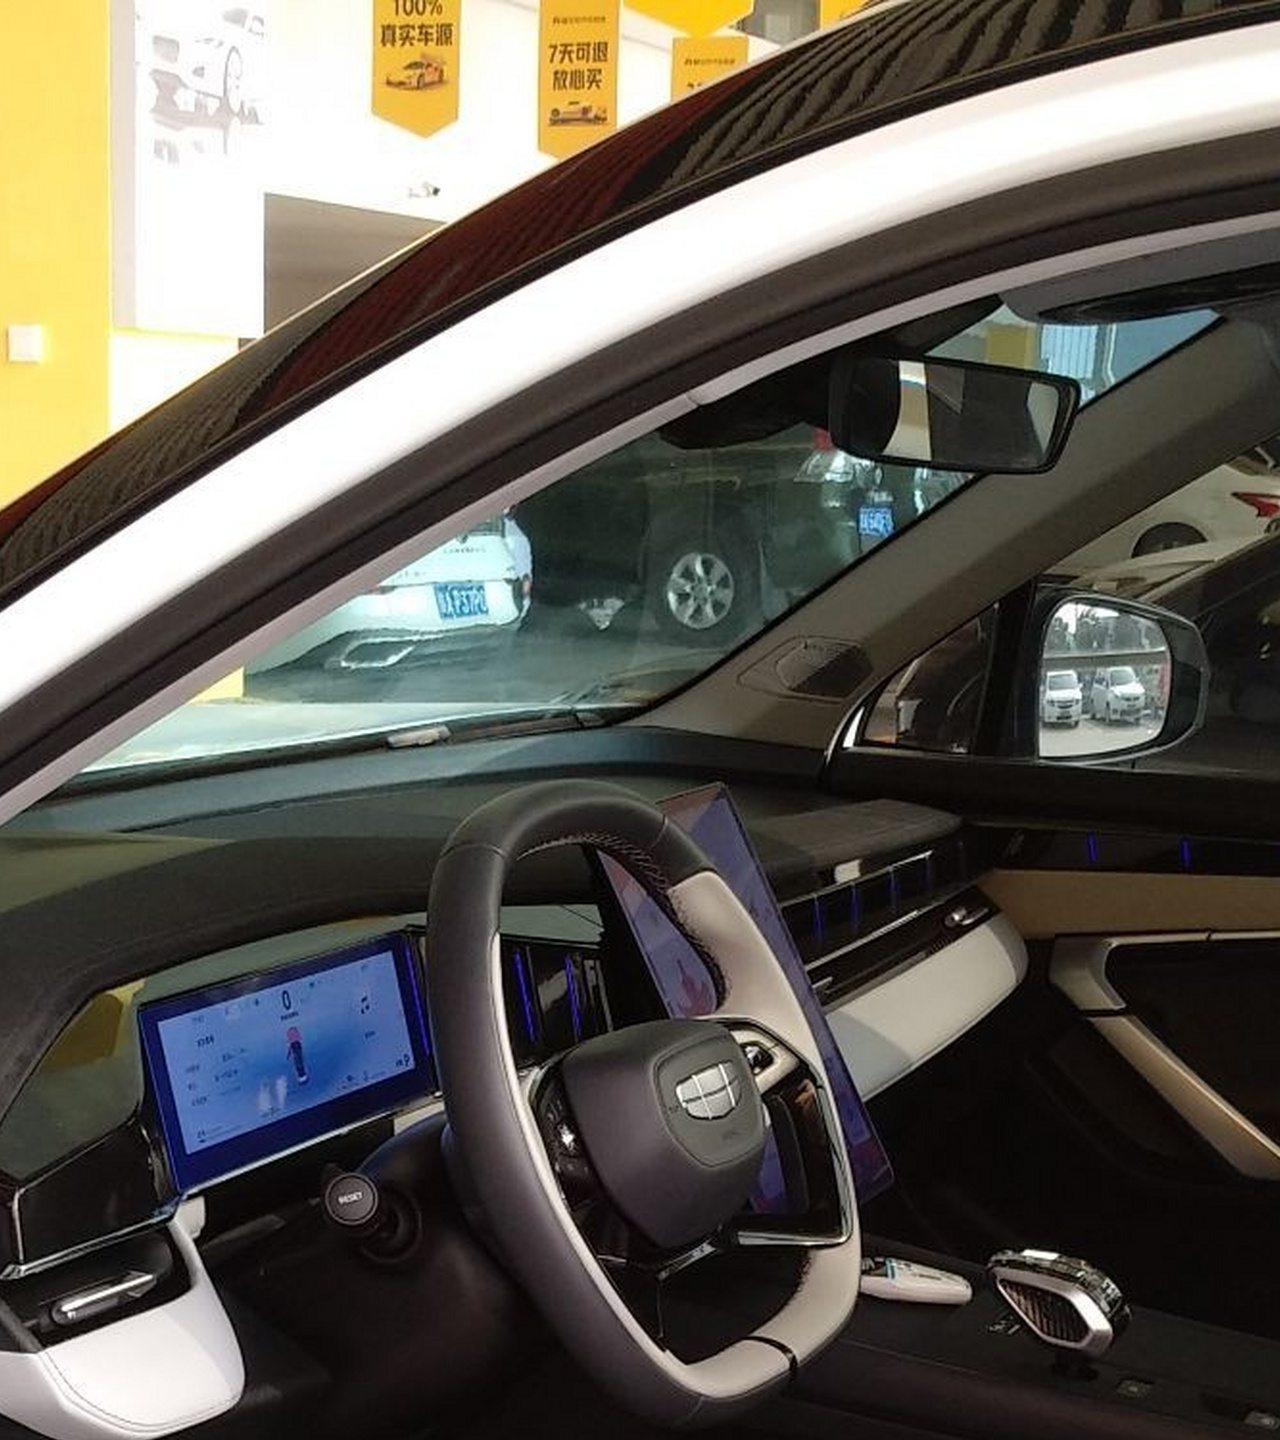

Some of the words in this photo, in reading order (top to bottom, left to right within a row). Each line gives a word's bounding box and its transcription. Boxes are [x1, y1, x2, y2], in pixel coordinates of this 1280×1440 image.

[380, 22, 454, 47] 真实车源
[548, 41, 608, 64] 7天可退
[552, 68, 602, 92] 放心买
[282, 990, 291, 1010] 0
